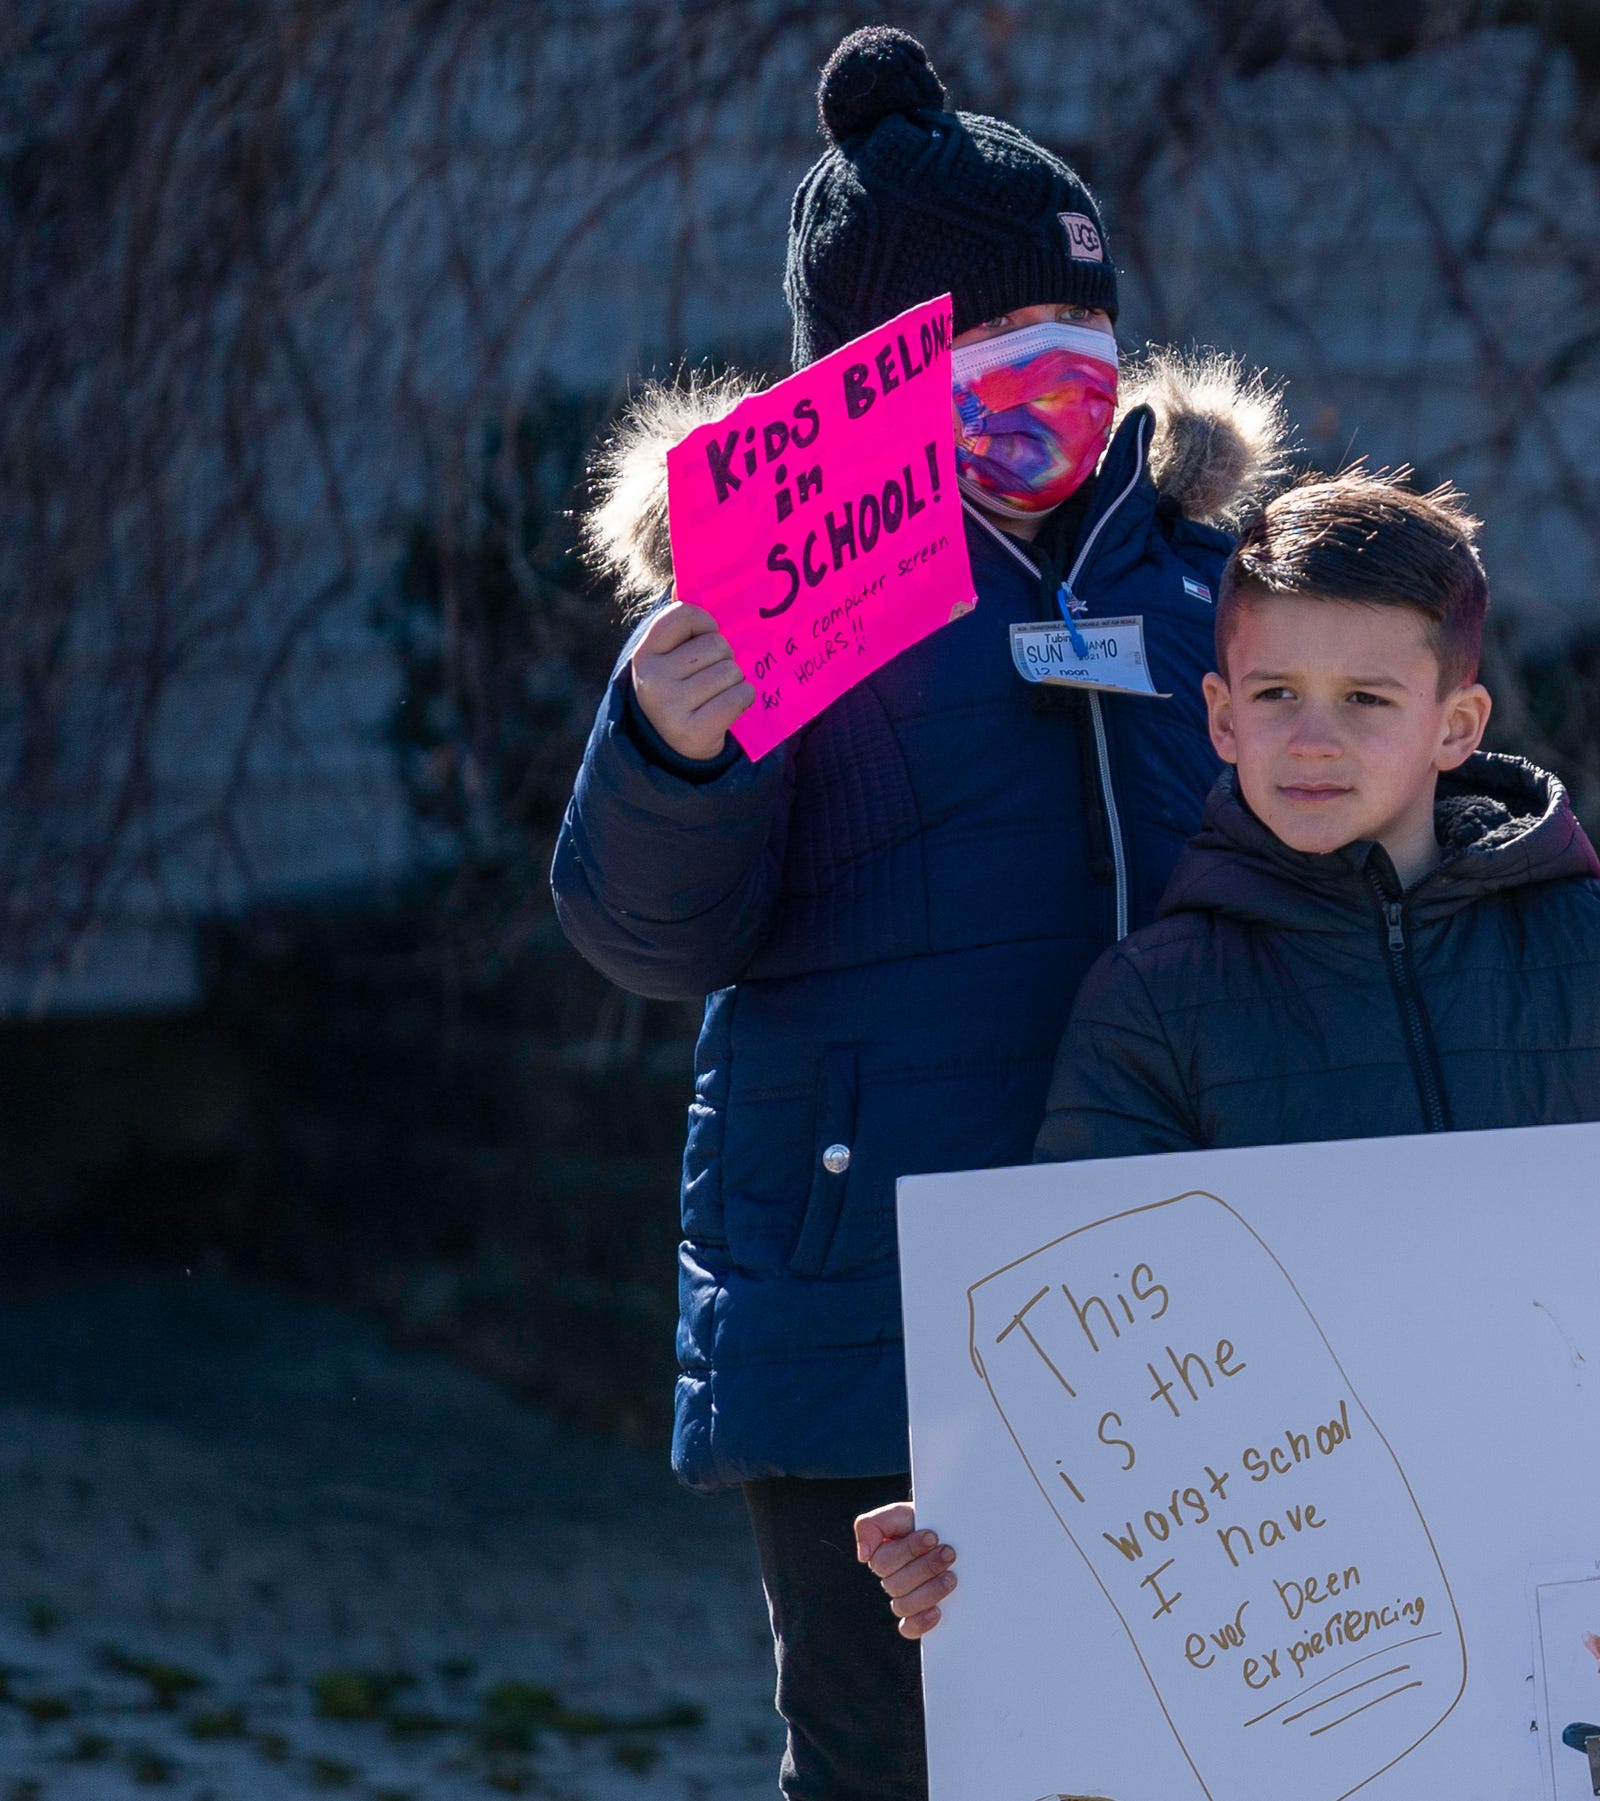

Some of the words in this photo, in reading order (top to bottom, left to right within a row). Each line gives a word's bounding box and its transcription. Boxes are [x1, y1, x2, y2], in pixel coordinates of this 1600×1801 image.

[758, 441, 942, 619] SCHOOL!
[774, 462, 824, 523] in
[754, 651, 778, 680] on
[785, 637, 799, 656] a
[812, 574, 886, 639] computer
[898, 535, 949, 577] screen
[1026, 643, 1064, 664] SUN
[1059, 668, 1089, 676] noon
[996, 1262, 1170, 1398] This
[1147, 1337, 1247, 1418] the
[1103, 1466, 1230, 1562] worst
[1242, 1399, 1352, 1482] school
[1140, 1558, 1182, 1620] I
[1185, 1600, 1250, 1669] ever
[1273, 1566, 1360, 1620] been
